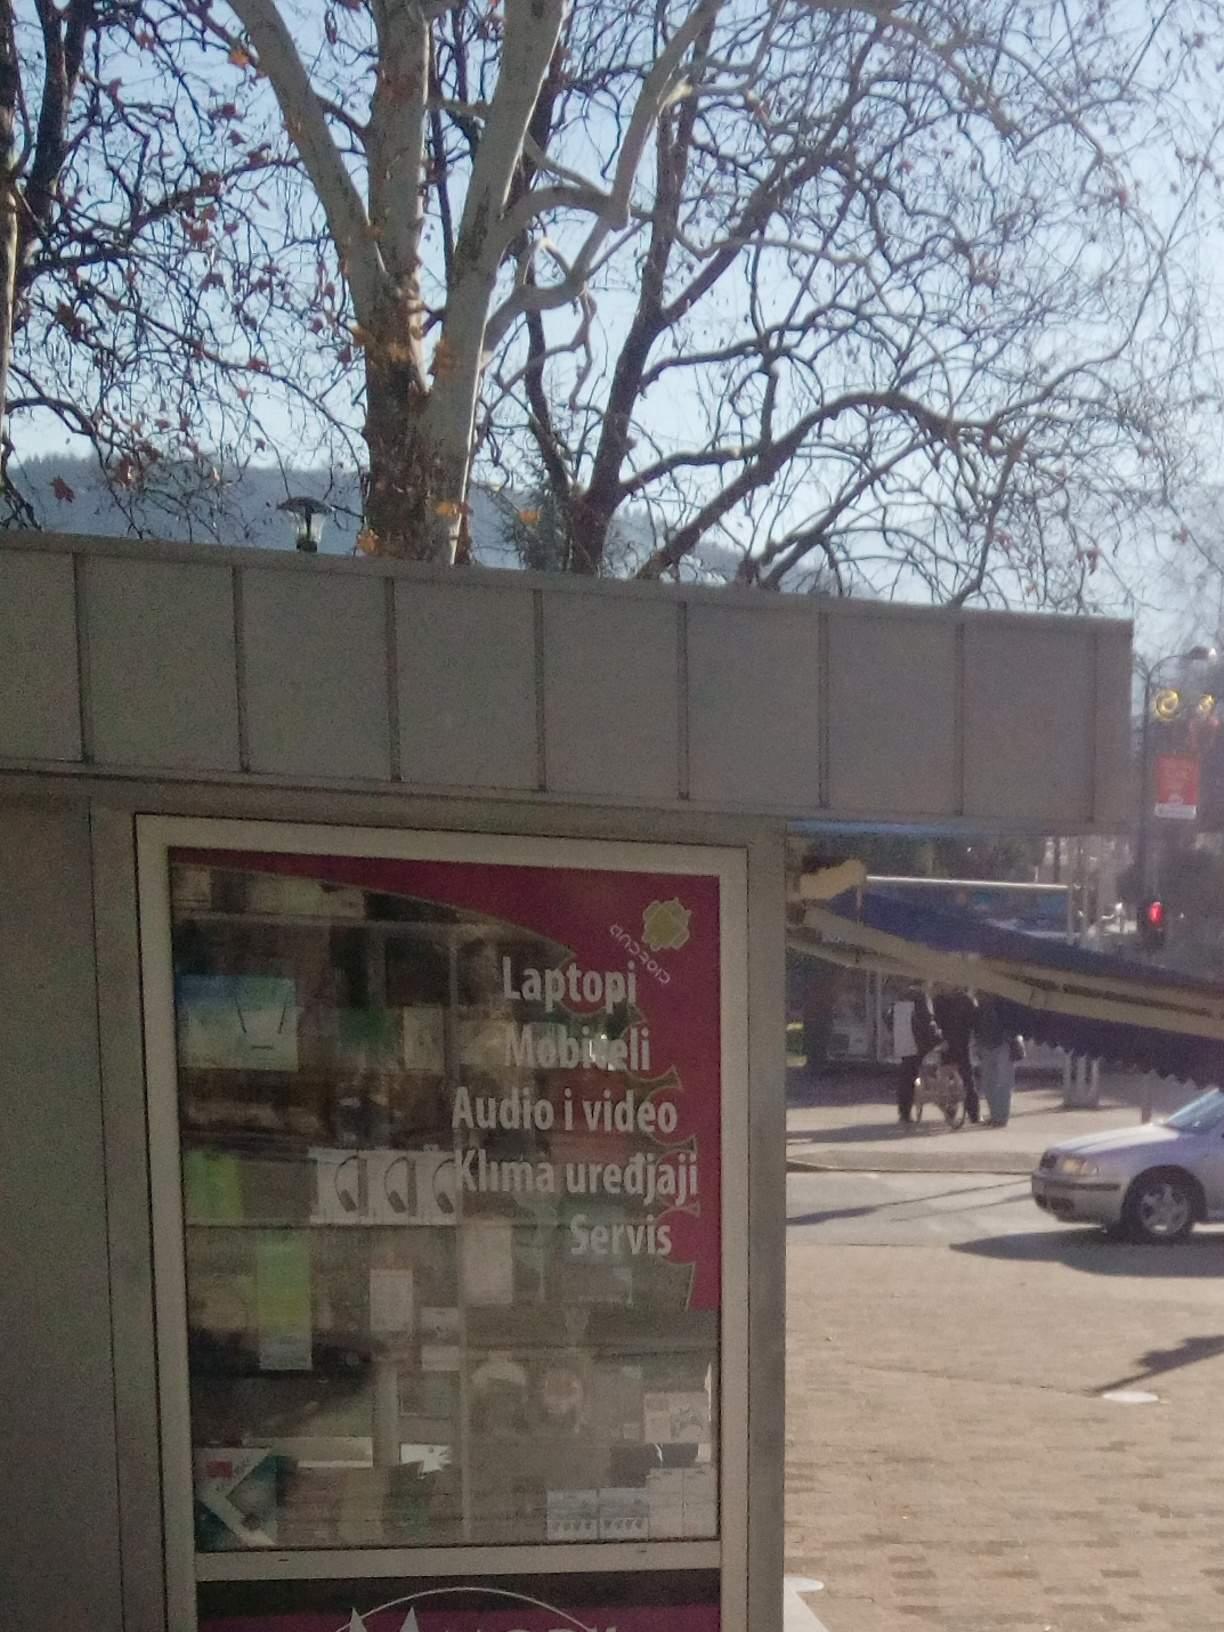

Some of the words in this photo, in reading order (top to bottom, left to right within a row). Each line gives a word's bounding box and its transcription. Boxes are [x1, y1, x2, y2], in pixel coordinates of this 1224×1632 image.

[502, 956, 636, 1013] Laptopi
[452, 1085, 555, 1130] Audio
[564, 1087, 573, 1131] i
[582, 1089, 678, 1133] video
[570, 1213, 672, 1256] Servis
